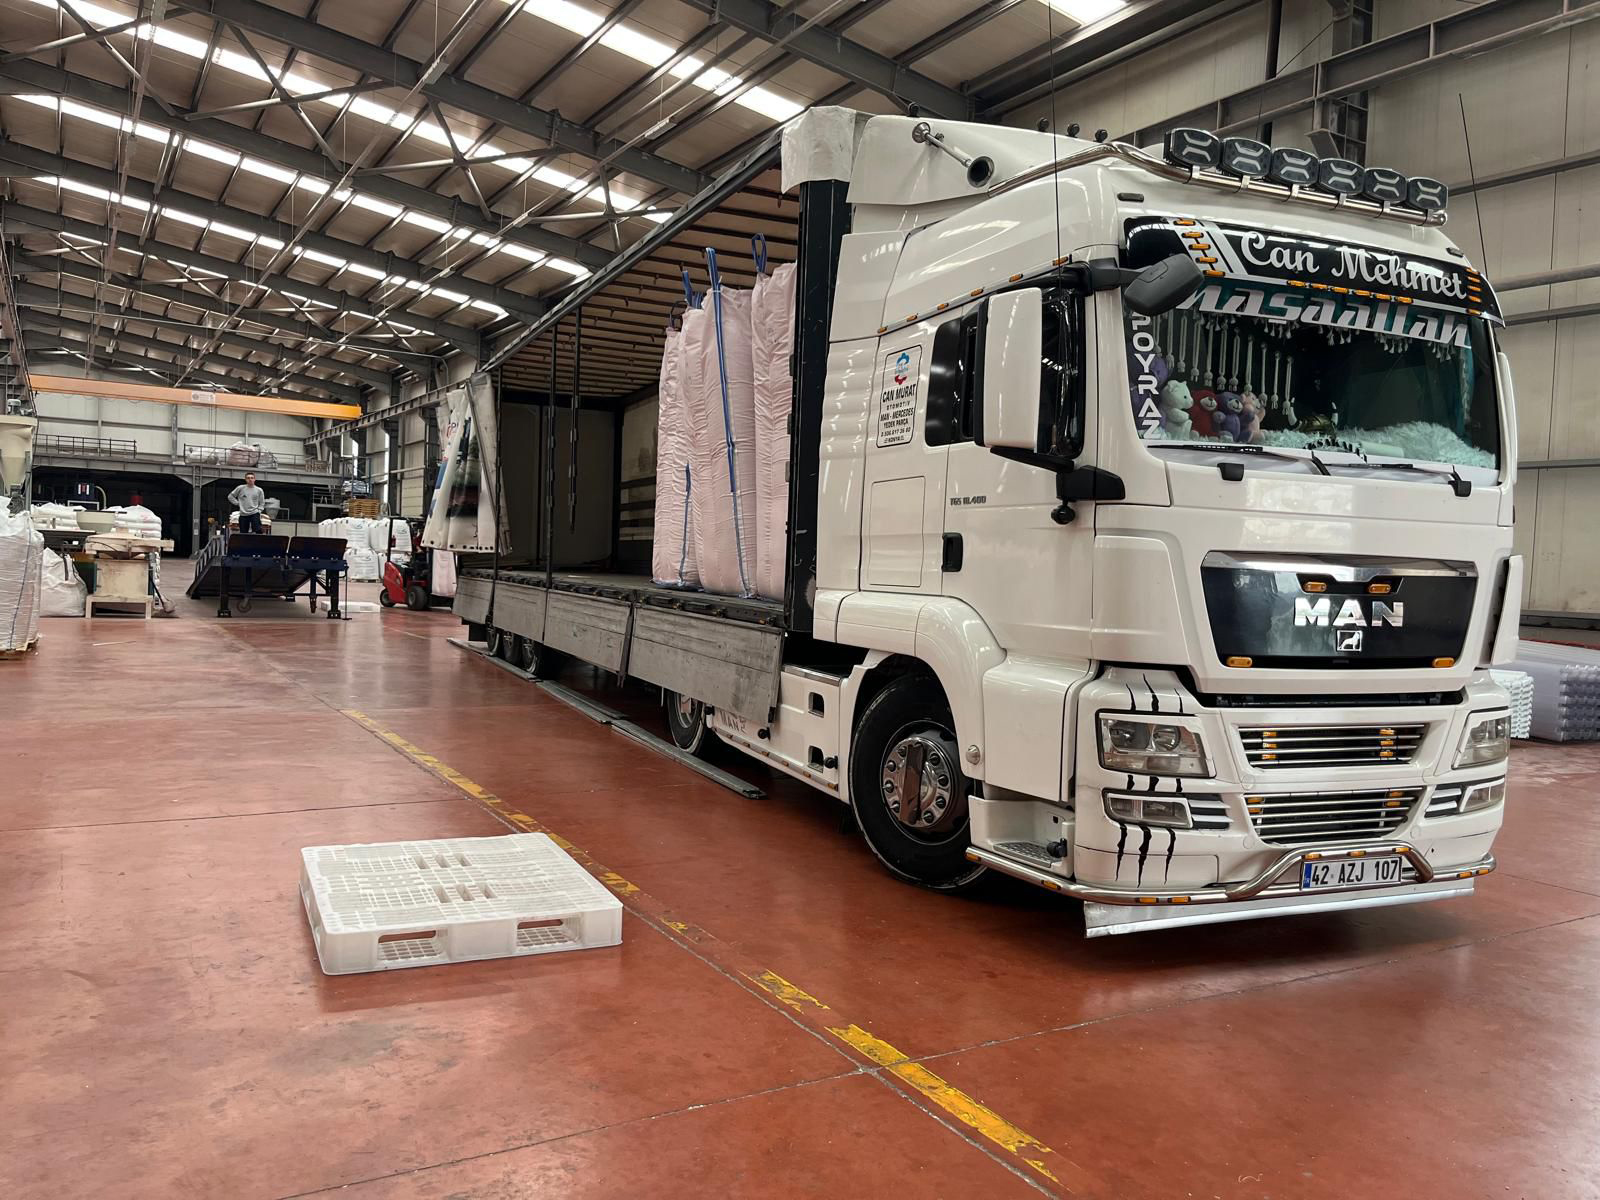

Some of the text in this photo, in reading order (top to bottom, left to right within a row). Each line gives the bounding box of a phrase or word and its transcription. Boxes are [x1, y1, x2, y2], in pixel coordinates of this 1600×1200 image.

[1241, 231, 1467, 299] Can Mehmet
[1131, 312, 1162, 440] POYRAZ
[882, 384, 916, 402] CAN MURAT
[880, 413, 890, 421] MAN
[892, 408, 913, 419] MERCEDES
[884, 420, 895, 428] YEDEK
[1294, 598, 1404, 627] MAN
[1312, 860, 1399, 885] 42 AZJ 107
